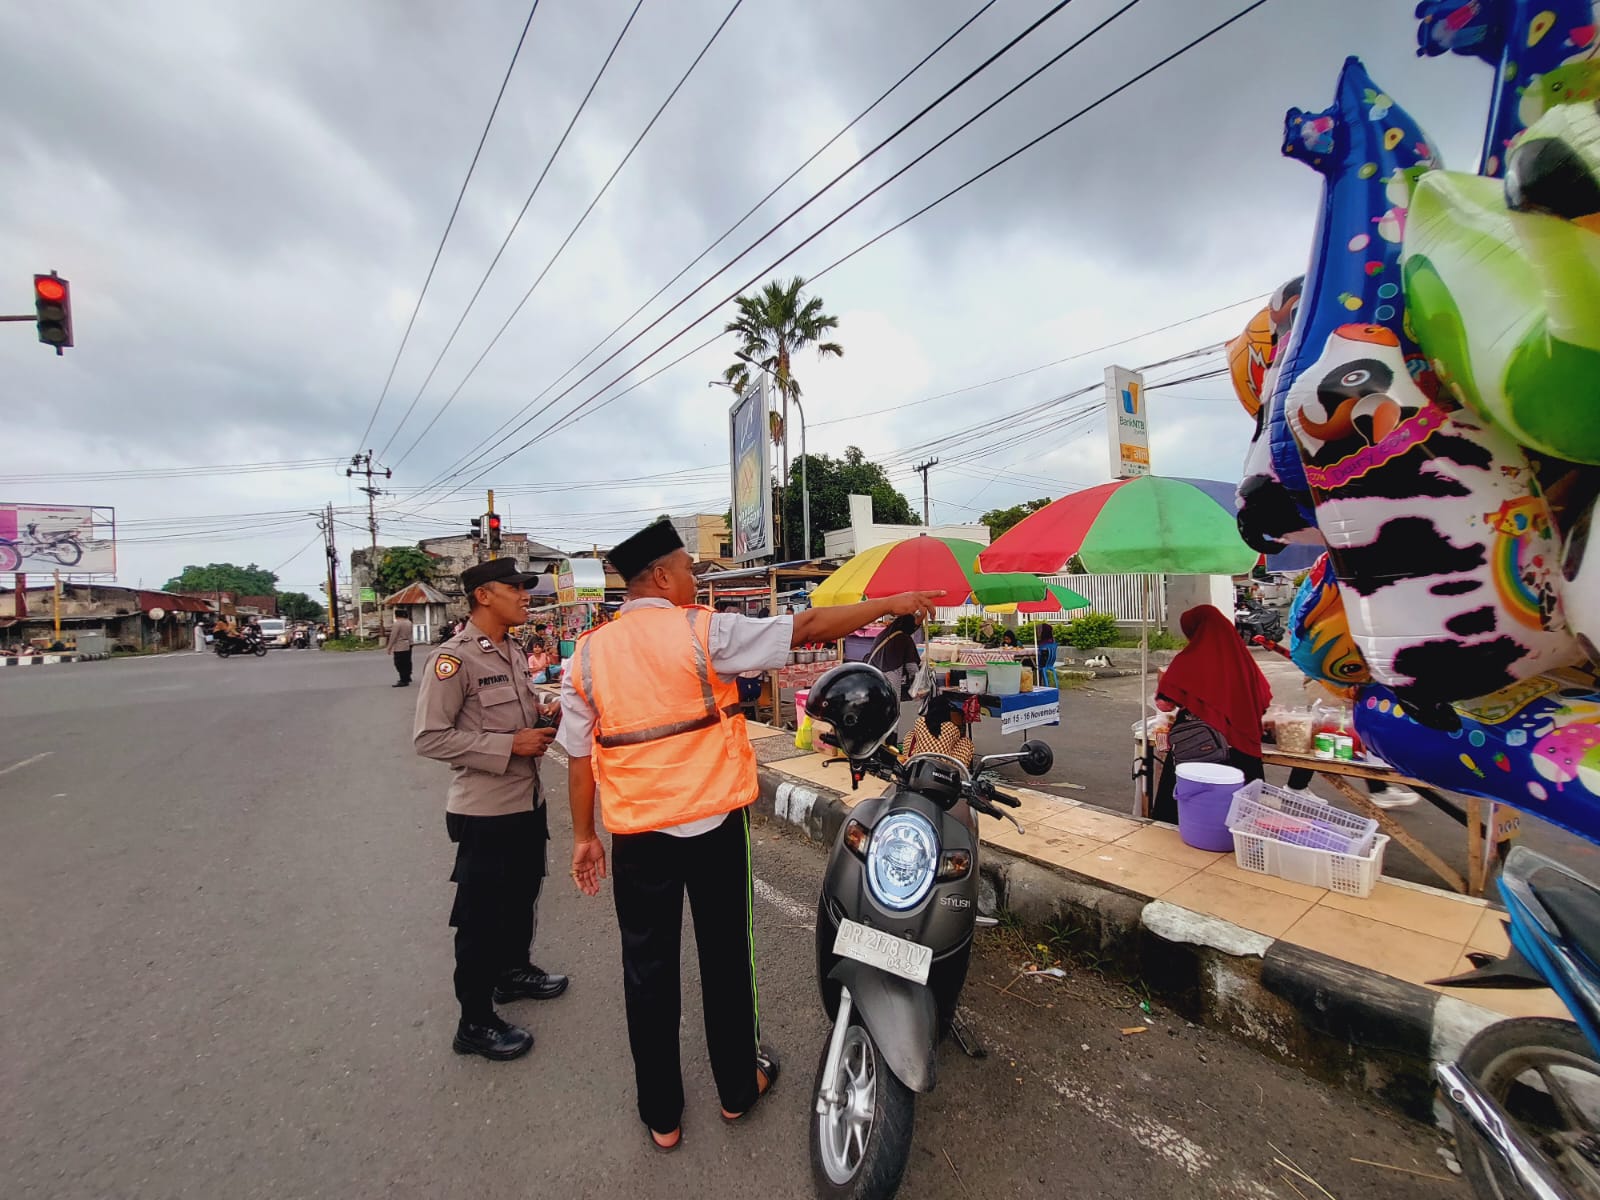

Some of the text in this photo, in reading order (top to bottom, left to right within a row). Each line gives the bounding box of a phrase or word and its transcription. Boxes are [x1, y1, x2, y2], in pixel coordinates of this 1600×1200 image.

[478, 675, 509, 686] PRIYANTO
[1013, 714, 1020, 723] 15
[1031, 707, 1056, 718] November
[940, 897, 971, 908] STYLISH
[841, 922, 862, 944] DR
[865, 931, 899, 957] 2178
[906, 943, 928, 965] TV
